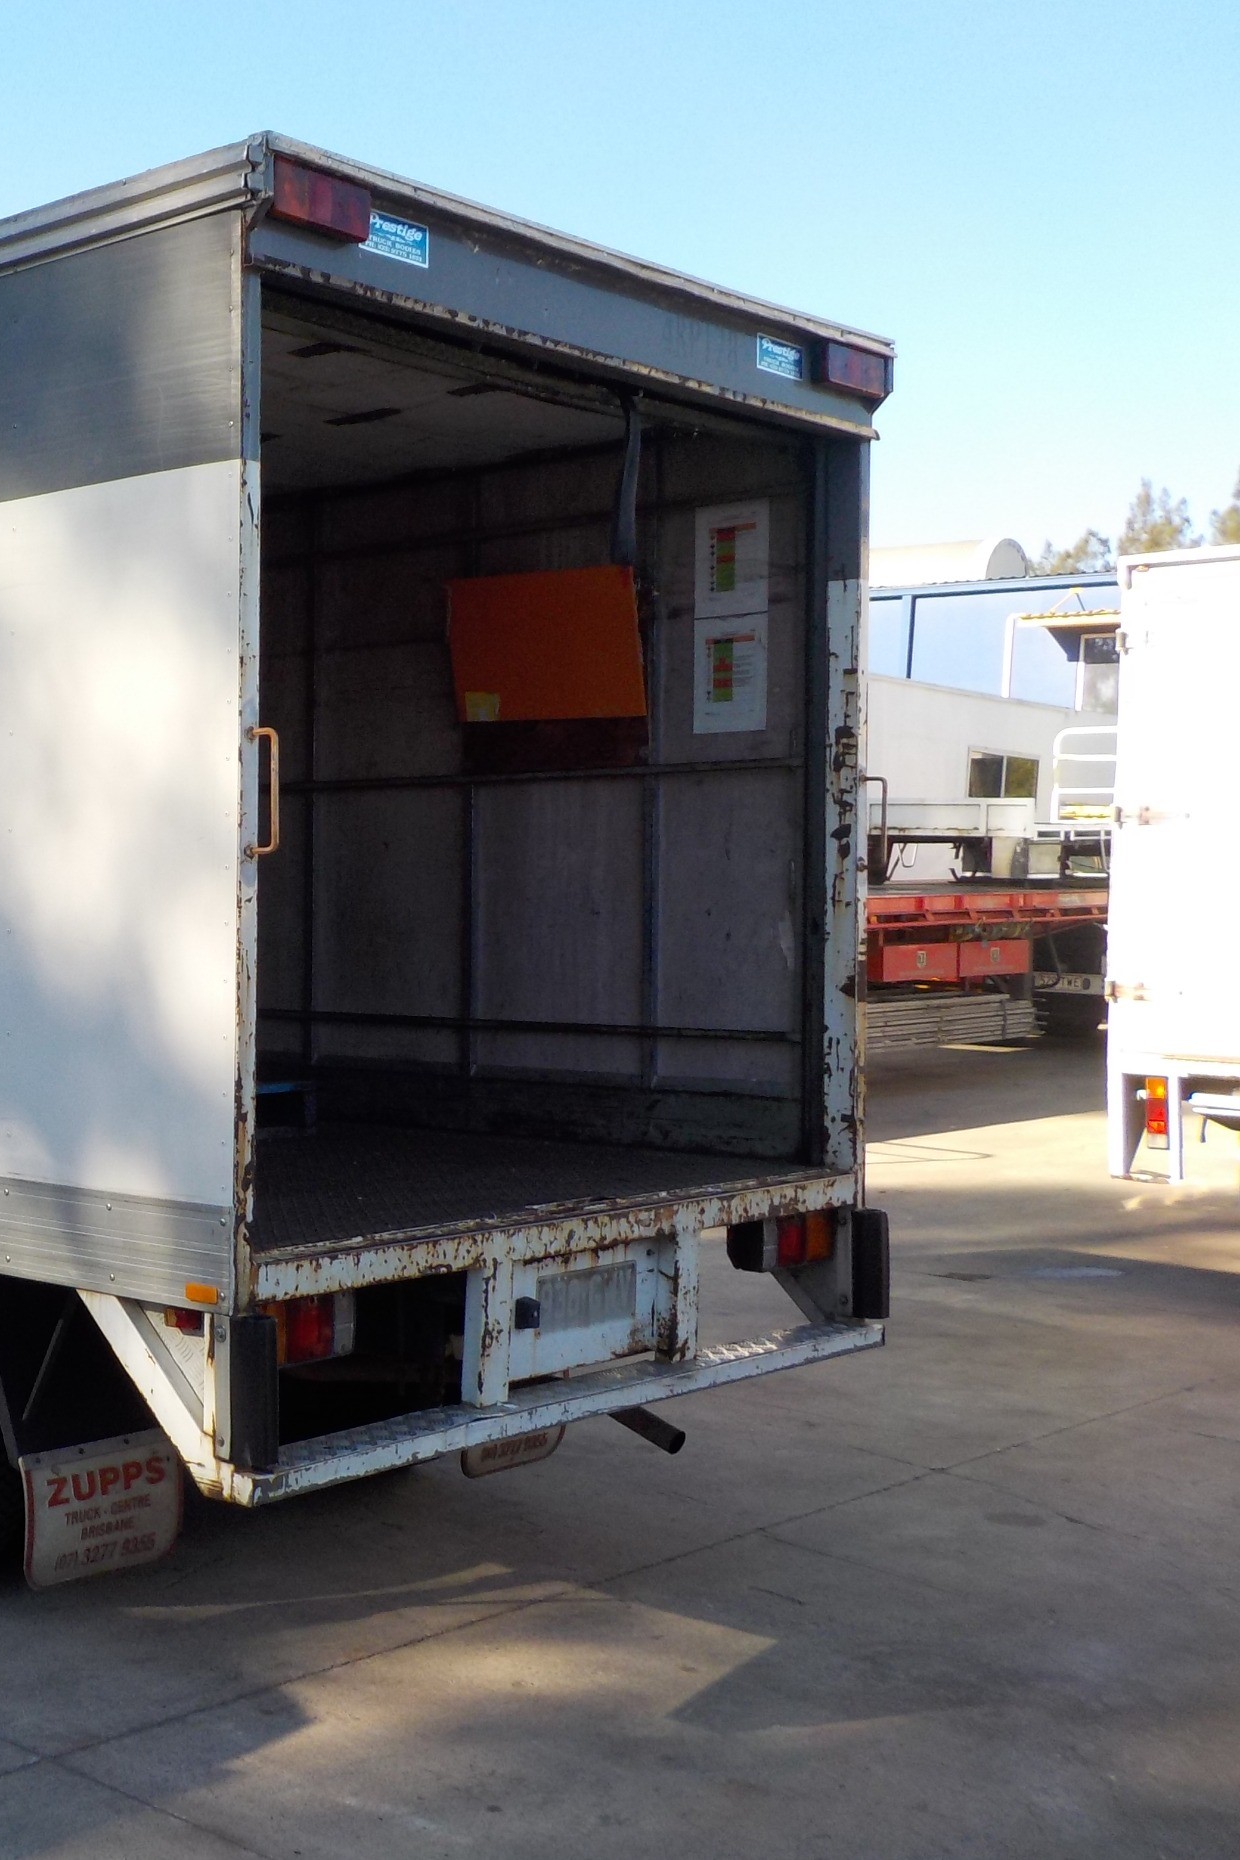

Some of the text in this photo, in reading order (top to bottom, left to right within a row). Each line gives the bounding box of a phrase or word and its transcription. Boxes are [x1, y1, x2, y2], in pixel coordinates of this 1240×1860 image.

[370, 212, 422, 241] Prestige
[46, 1456, 168, 1508] ZUPPS
[64, 1506, 102, 1527] TRUCK
[80, 1516, 135, 1541] BRISBANE
